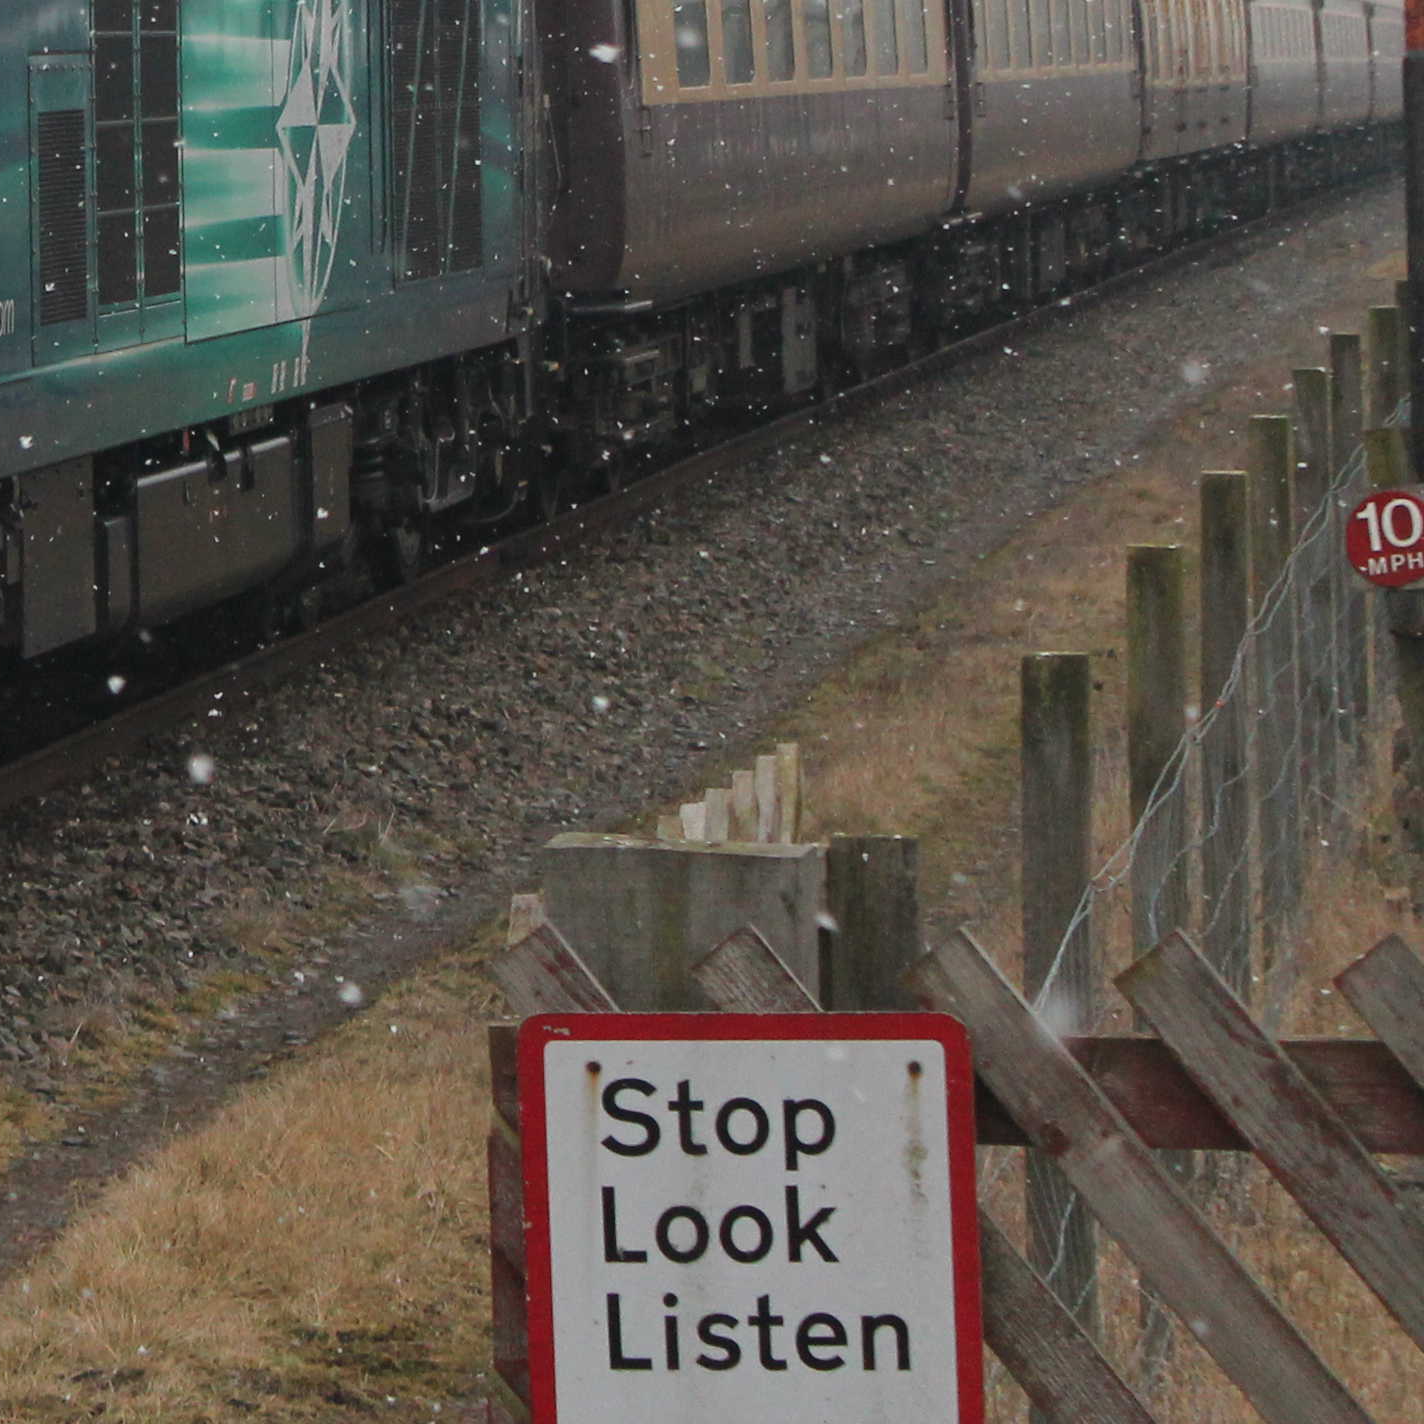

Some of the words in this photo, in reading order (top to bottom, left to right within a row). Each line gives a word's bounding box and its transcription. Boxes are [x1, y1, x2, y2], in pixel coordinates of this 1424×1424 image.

[1356, 498, 1423, 552] 10
[1367, 551, 1424, 576] MPH
[600, 1078, 836, 1171] Stop
[601, 1185, 840, 1264] Look
[606, 1292, 911, 1371] Listen
